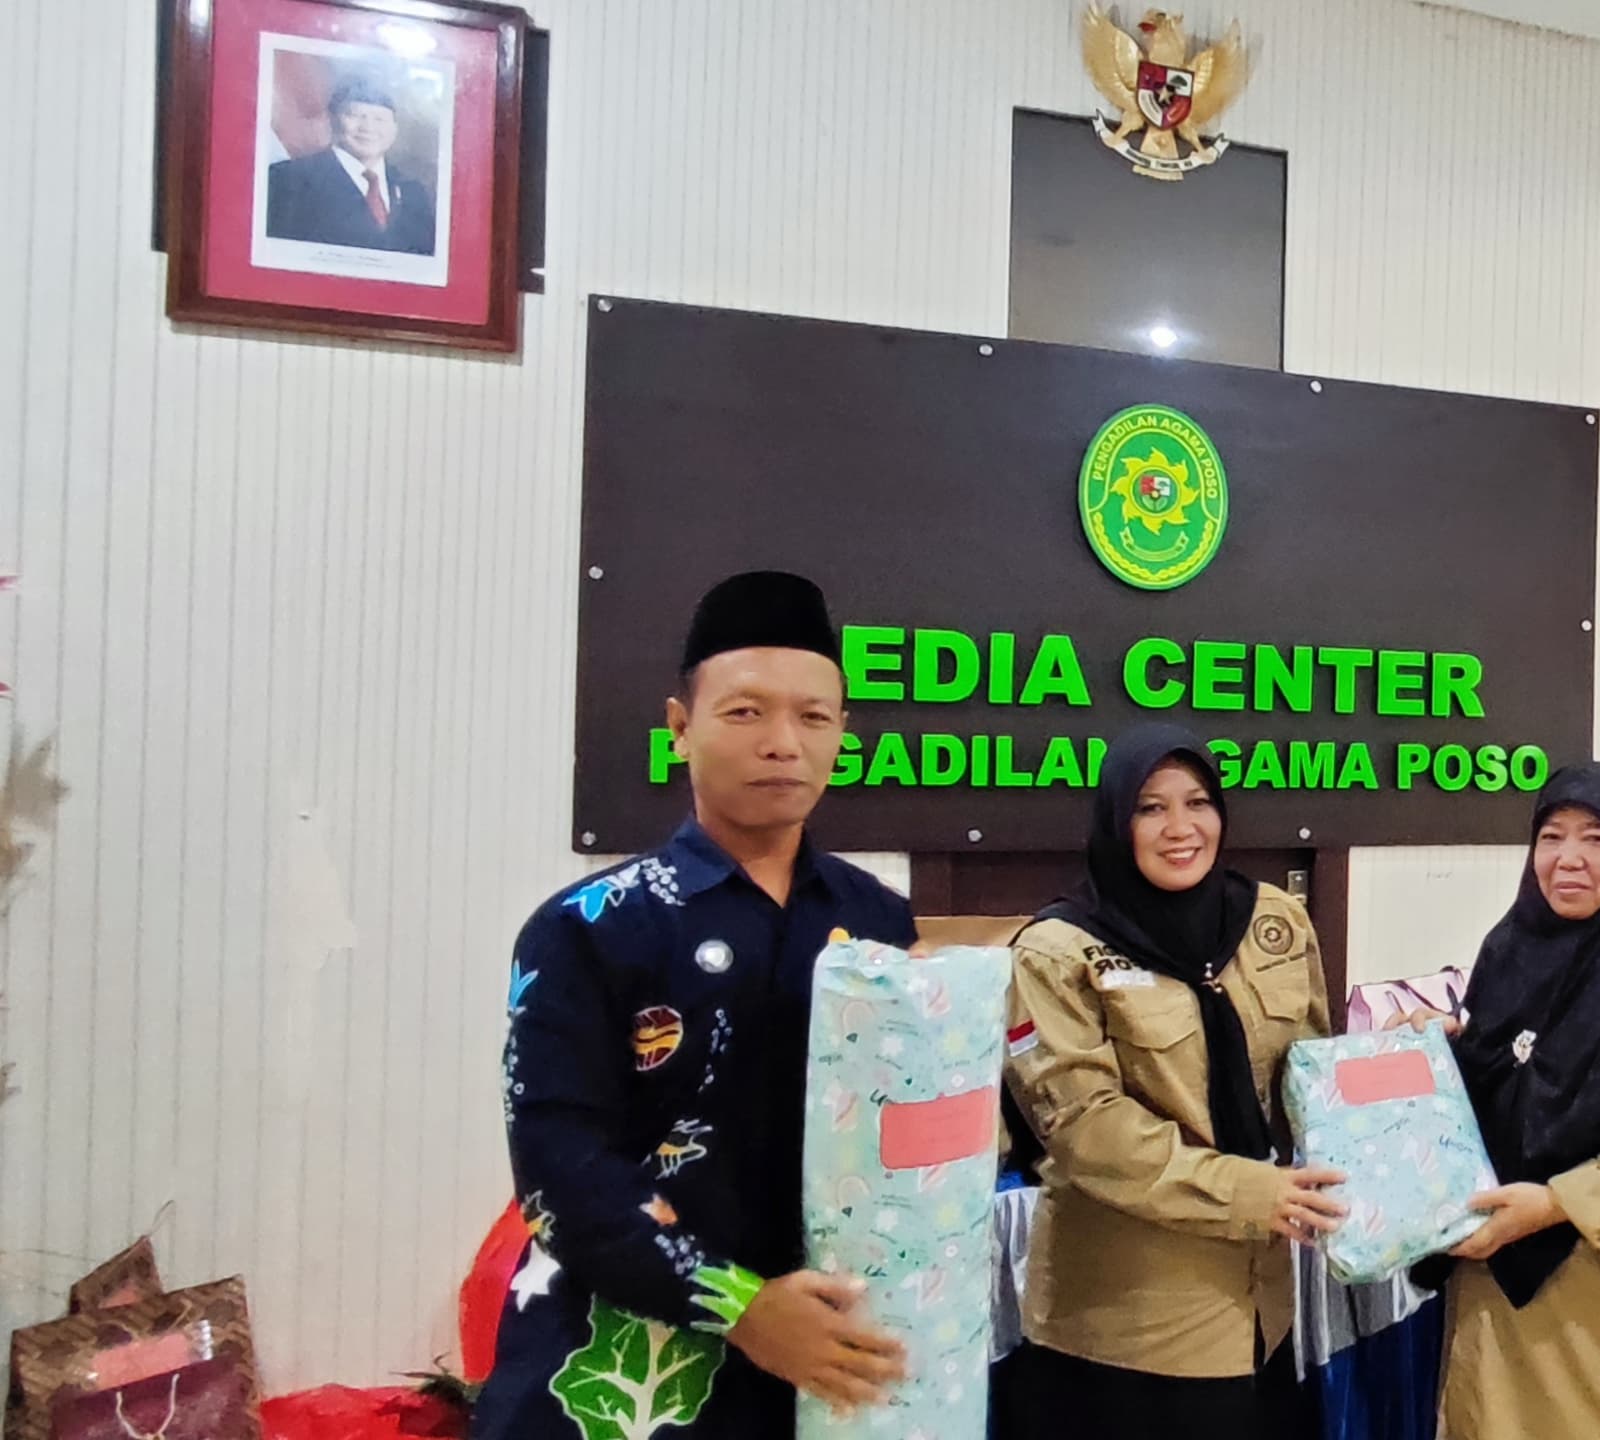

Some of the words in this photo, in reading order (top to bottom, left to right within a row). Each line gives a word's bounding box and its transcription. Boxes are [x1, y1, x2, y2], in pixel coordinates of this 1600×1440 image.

[1092, 415, 1158, 481] PENGADILAN
[1159, 417, 1207, 459] AGAMA
[1199, 457, 1219, 500] POSO
[841, 624, 1092, 707] EDIA
[1122, 636, 1486, 719] CENTER
[649, 728, 1108, 788] PGADILA
[1206, 738, 1380, 790] GAMA
[1396, 743, 1550, 793] POSO
